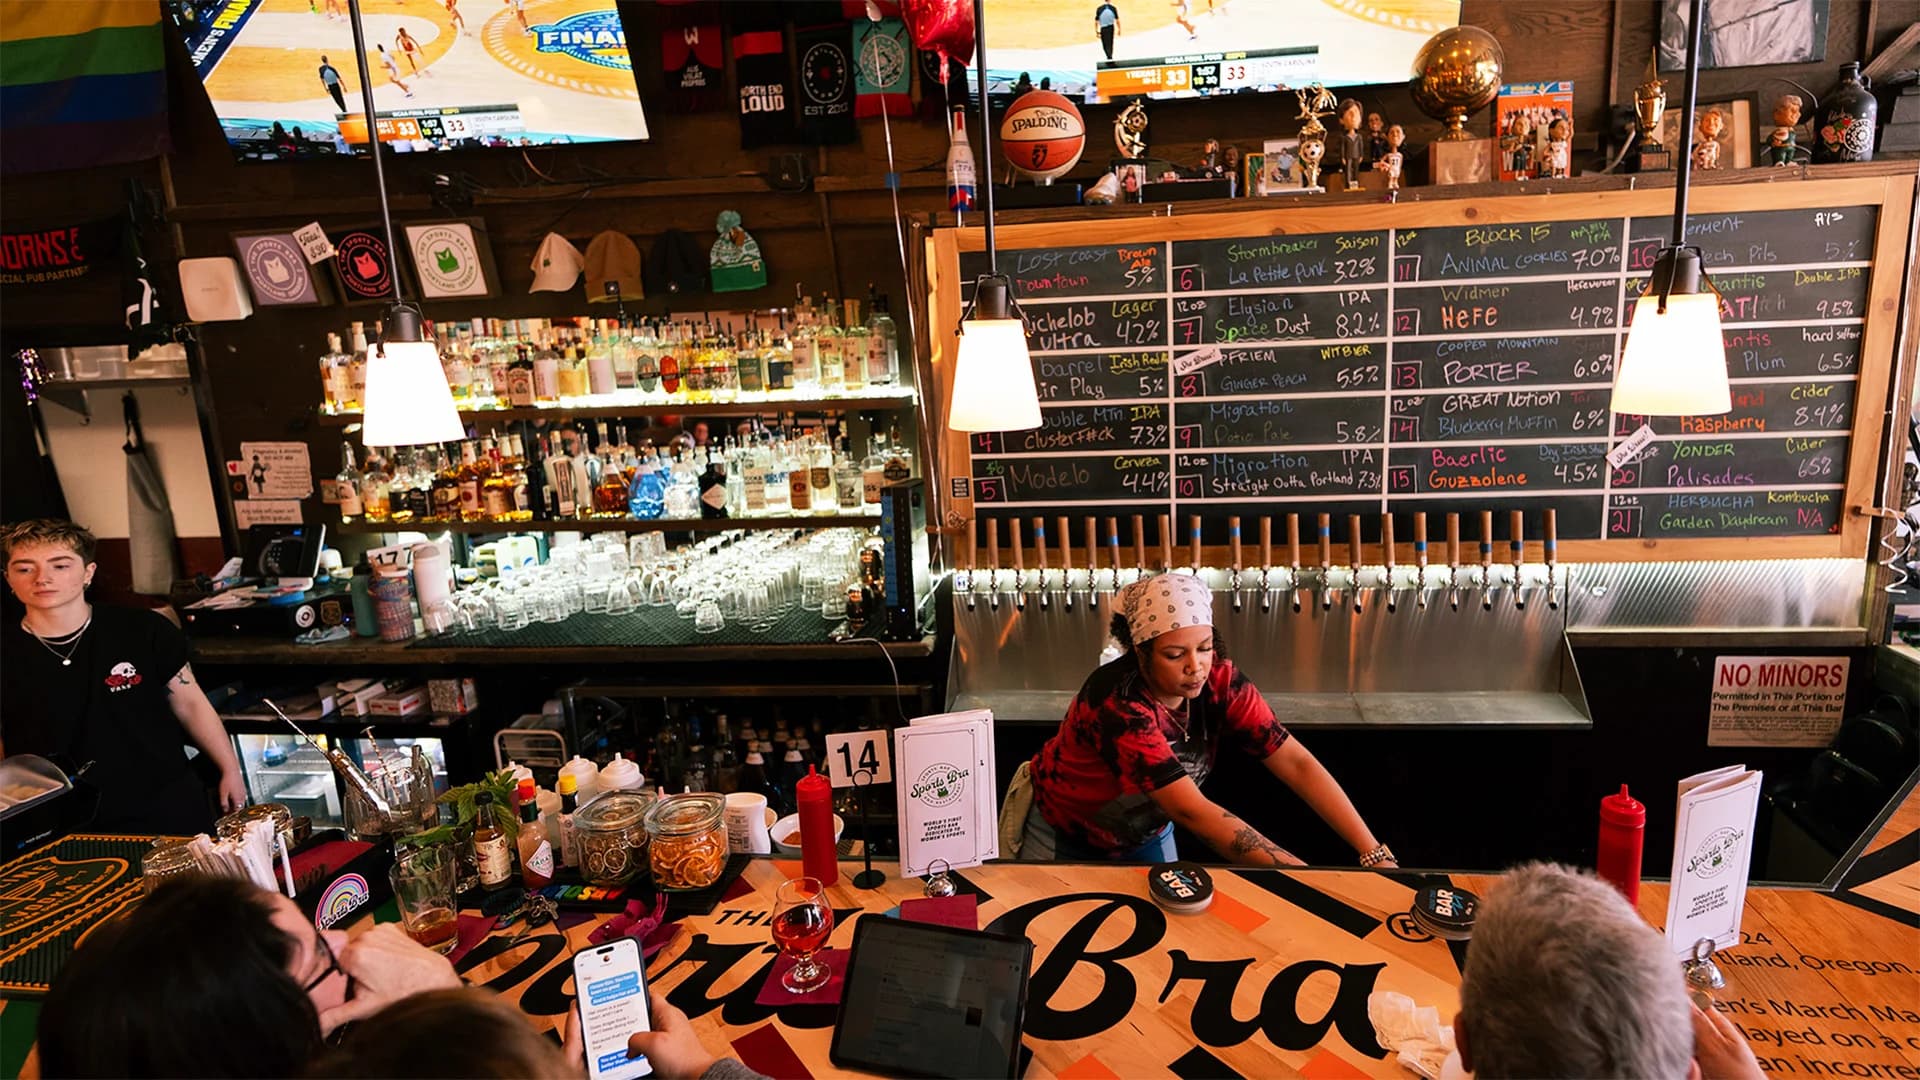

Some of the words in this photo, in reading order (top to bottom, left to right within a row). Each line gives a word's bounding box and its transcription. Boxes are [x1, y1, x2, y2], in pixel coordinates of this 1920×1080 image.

[1166, 70, 1187, 86] 33
[1227, 66, 1246, 81] 33
[740, 85, 766, 98] NORTH
[741, 95, 785, 114] LOUD
[397, 121, 417, 136] 33
[447, 119, 466, 132] 33
[1011, 116, 1068, 133] SPALDING
[1334, 235, 1380, 255] Saison
[1529, 223, 1551, 244] 15
[1440, 252, 1510, 276] ANIMAL
[1514, 249, 1569, 270] COOKIES
[1571, 246, 1621, 271] 7.0%
[1630, 243, 1658, 269] 16
[1123, 266, 1157, 289] 5%
[1179, 268, 1194, 291] 6
[1228, 269, 1249, 286] La
[1793, 270, 1834, 287] Double
[1111, 299, 1157, 320] Lager
[1338, 290, 1372, 307] IPA
[1178, 321, 1195, 345] 7
[1214, 318, 1271, 342] Space
[1274, 312, 1313, 335] Dust
[1334, 312, 1381, 340] 8.2%
[1395, 314, 1413, 333] 12
[1569, 305, 1615, 328] 4.9%
[1801, 326, 1834, 342] hard
[1319, 344, 1372, 360] WITBIER
[1743, 350, 1787, 372] Plum
[1396, 367, 1417, 387] 13
[1443, 360, 1539, 386] PORTER
[1573, 353, 1614, 378] 6.0%
[1070, 377, 1105, 400] Play
[1138, 375, 1165, 397] 5%
[1180, 375, 1197, 398] 8
[1789, 383, 1835, 401] Cider
[1209, 400, 1294, 424] Migration
[1442, 392, 1503, 414] GREAT
[1041, 409, 1089, 429] ouble
[1129, 405, 1162, 422] IPA
[1392, 420, 1415, 442] 14
[1572, 408, 1605, 430] 6%
[977, 432, 994, 453] 4
[1179, 427, 1193, 449] 9
[1336, 421, 1382, 444] 5.8%
[1431, 446, 1508, 469] Baerlic
[1671, 439, 1736, 461] YONDER
[1784, 437, 1827, 455] Cider
[1009, 462, 1091, 493] Modelo
[1113, 456, 1163, 471] Cerveza
[1212, 452, 1310, 484] Migration
[1341, 449, 1375, 466] IPA
[1391, 470, 1411, 489] 15
[1428, 467, 1528, 490] Guzzolene
[1553, 462, 1599, 485] 4.5%
[1611, 468, 1636, 486] 20
[1667, 464, 1755, 488] Palisades
[980, 480, 998, 501] 5
[1121, 472, 1171, 494] 4.4%
[1179, 479, 1194, 497] 10
[1211, 474, 1270, 495] Straight
[1309, 467, 1354, 487] Portland
[1766, 490, 1831, 505] Kombucha
[1610, 509, 1632, 534] 21
[1659, 512, 1716, 531] Garden
[1796, 507, 1825, 528] N/A
[1720, 663, 1752, 687] NO
[1758, 663, 1843, 688] MINORS
[1713, 691, 1759, 700] Permitted
[1761, 691, 1770, 700] in
[1773, 691, 1793, 700] This
[1796, 691, 1832, 700] Portion
[1834, 691, 1845, 700] of
[1713, 702, 1730, 712] The
[1732, 703, 1776, 713] Premises
[1778, 704, 1788, 712] or
[1790, 703, 1801, 712] at
[1803, 703, 1823, 712] This
[1825, 703, 1842, 713] Bar
[836, 739, 880, 778] 14
[910, 777, 945, 798] Sports
[946, 768, 969, 785] Bra
[1160, 869, 1195, 898] BAR
[1435, 889, 1453, 917] BAR
[981, 892, 1390, 1060] Bra
[1767, 999, 1868, 1021] March
[1736, 1023, 1826, 1047] layed
[1831, 1031, 1876, 1048] on
